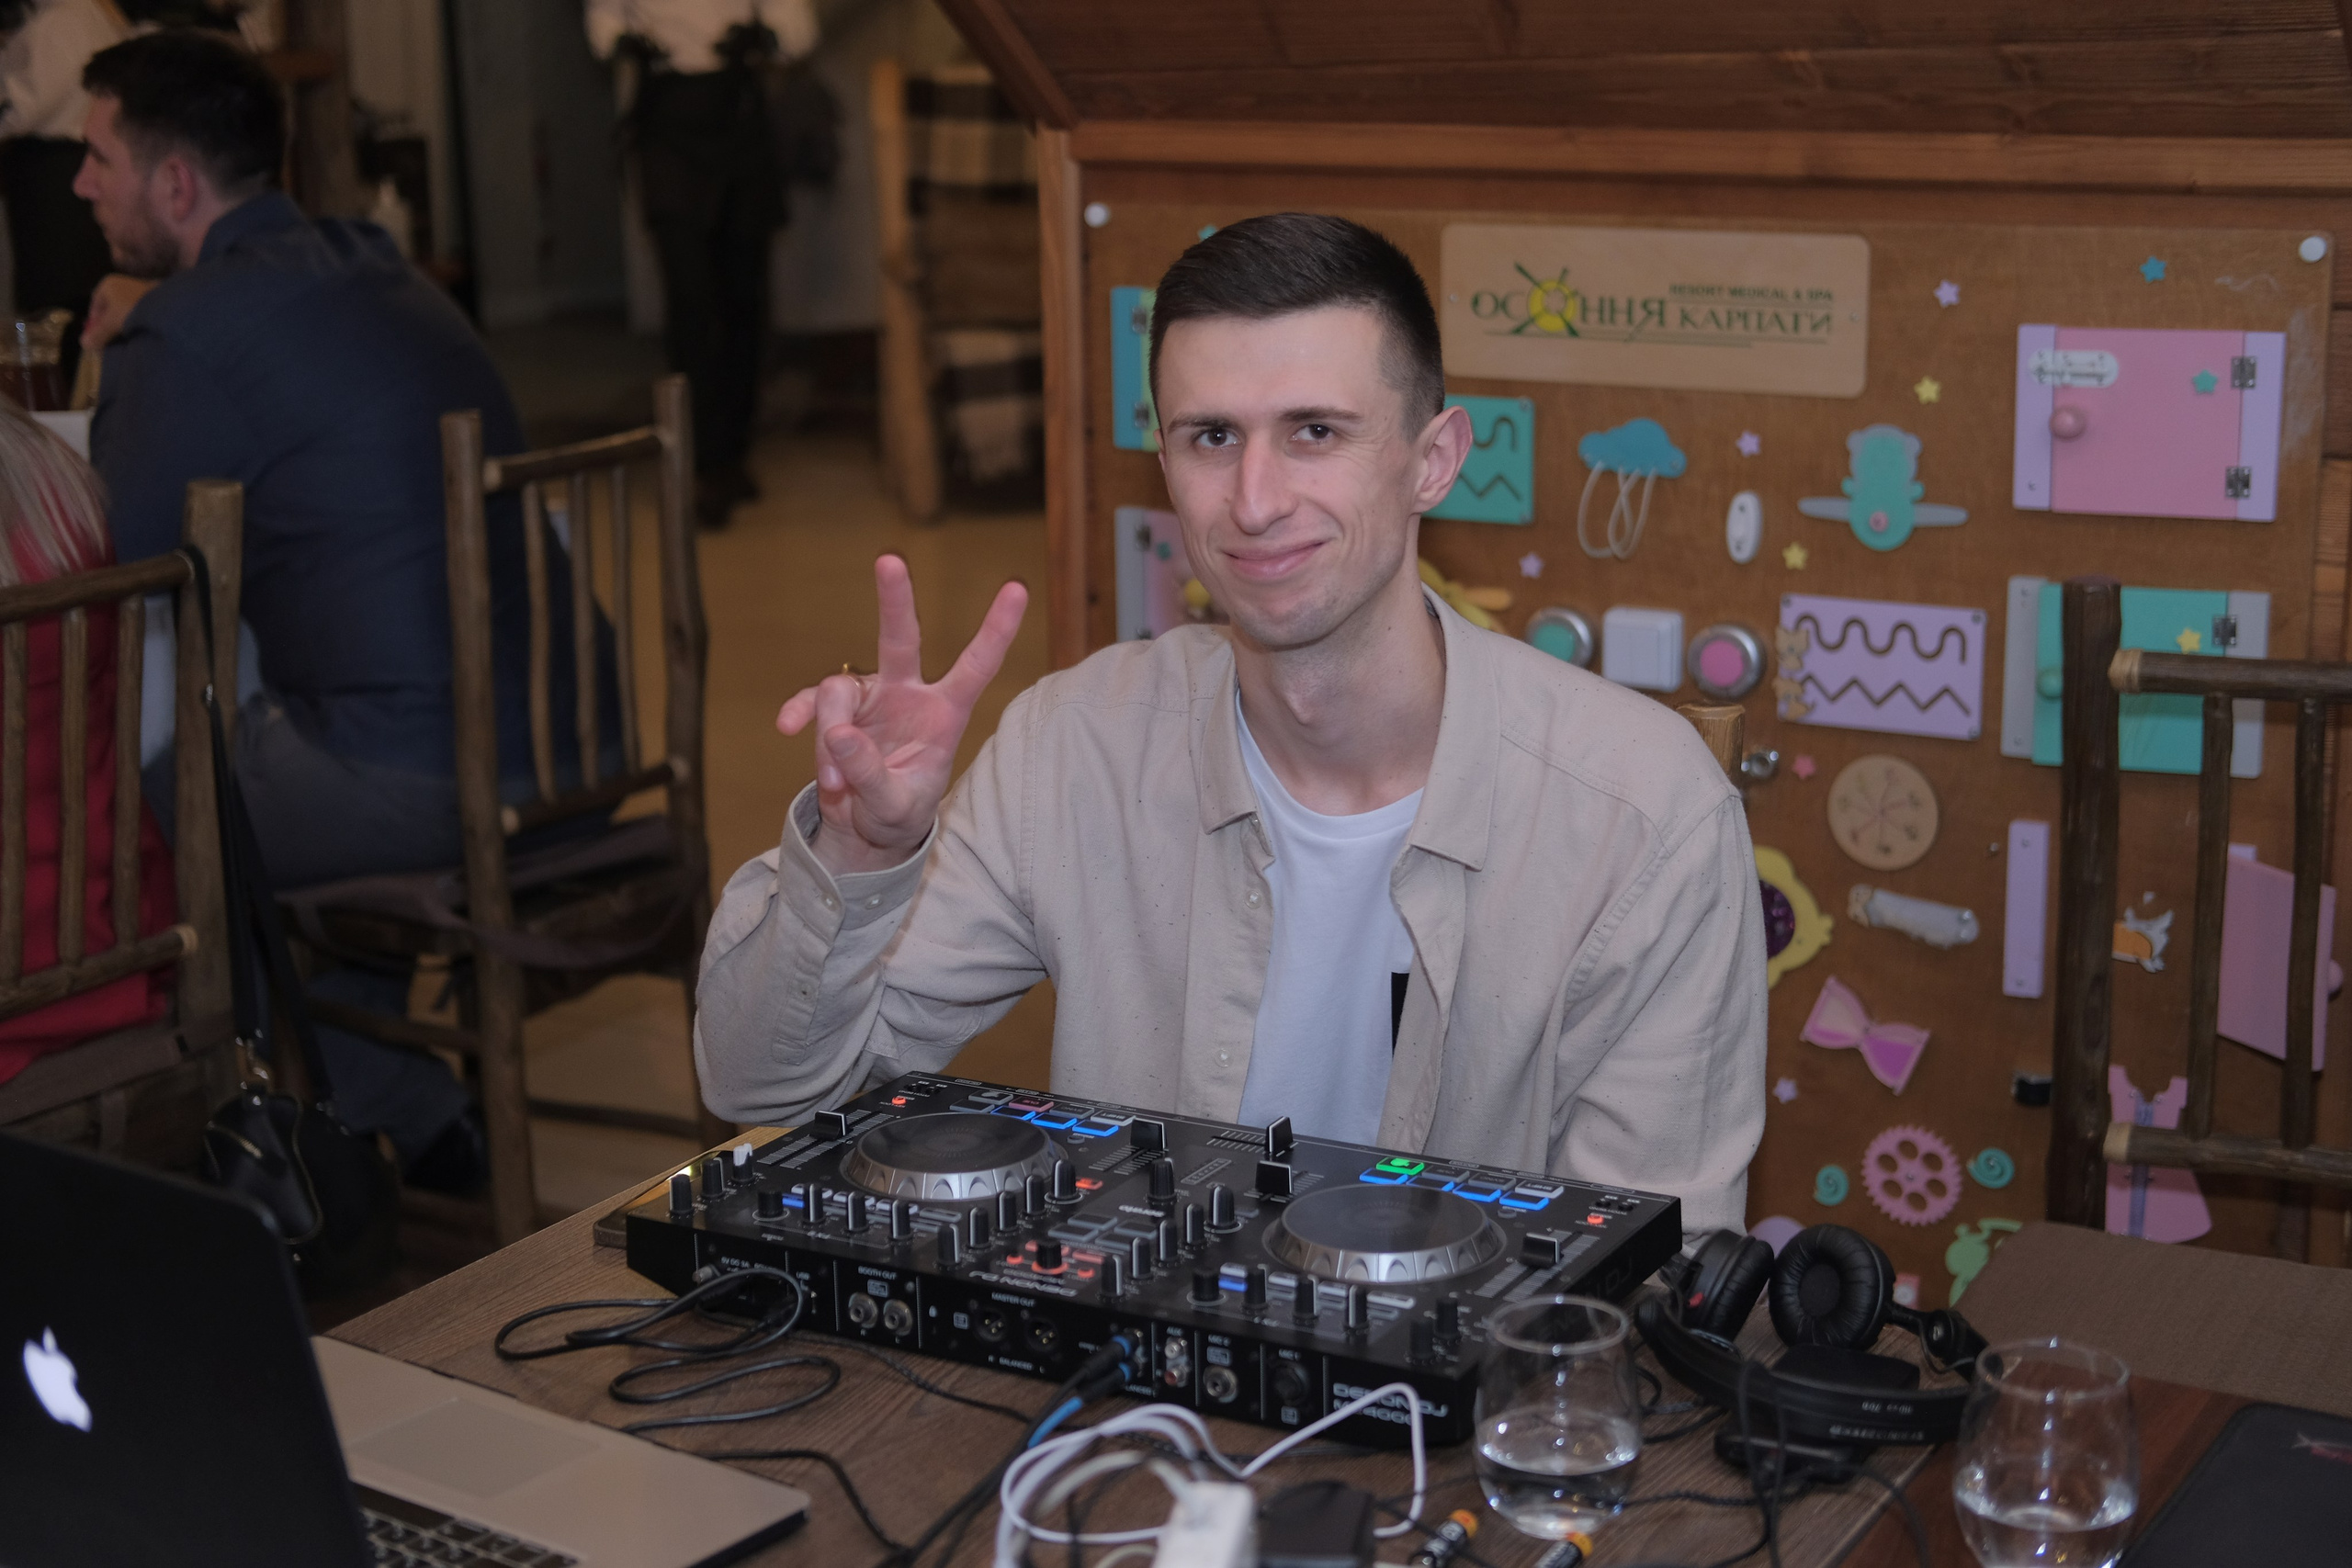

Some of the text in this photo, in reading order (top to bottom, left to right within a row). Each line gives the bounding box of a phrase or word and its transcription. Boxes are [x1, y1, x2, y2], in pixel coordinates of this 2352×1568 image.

[1728, 286, 1788, 299] MEDICAL
[1679, 306, 1833, 334] КАРПАТИ
[857, 1265, 898, 1280] BOOTH OUT
[1000, 1276, 1078, 1297] DENON
[991, 1292, 1035, 1308] MASTER OUT
[1207, 1334, 1223, 1346] MIC
[1278, 1348, 1294, 1360] MIC
[1418, 1399, 1449, 1418] DJ
